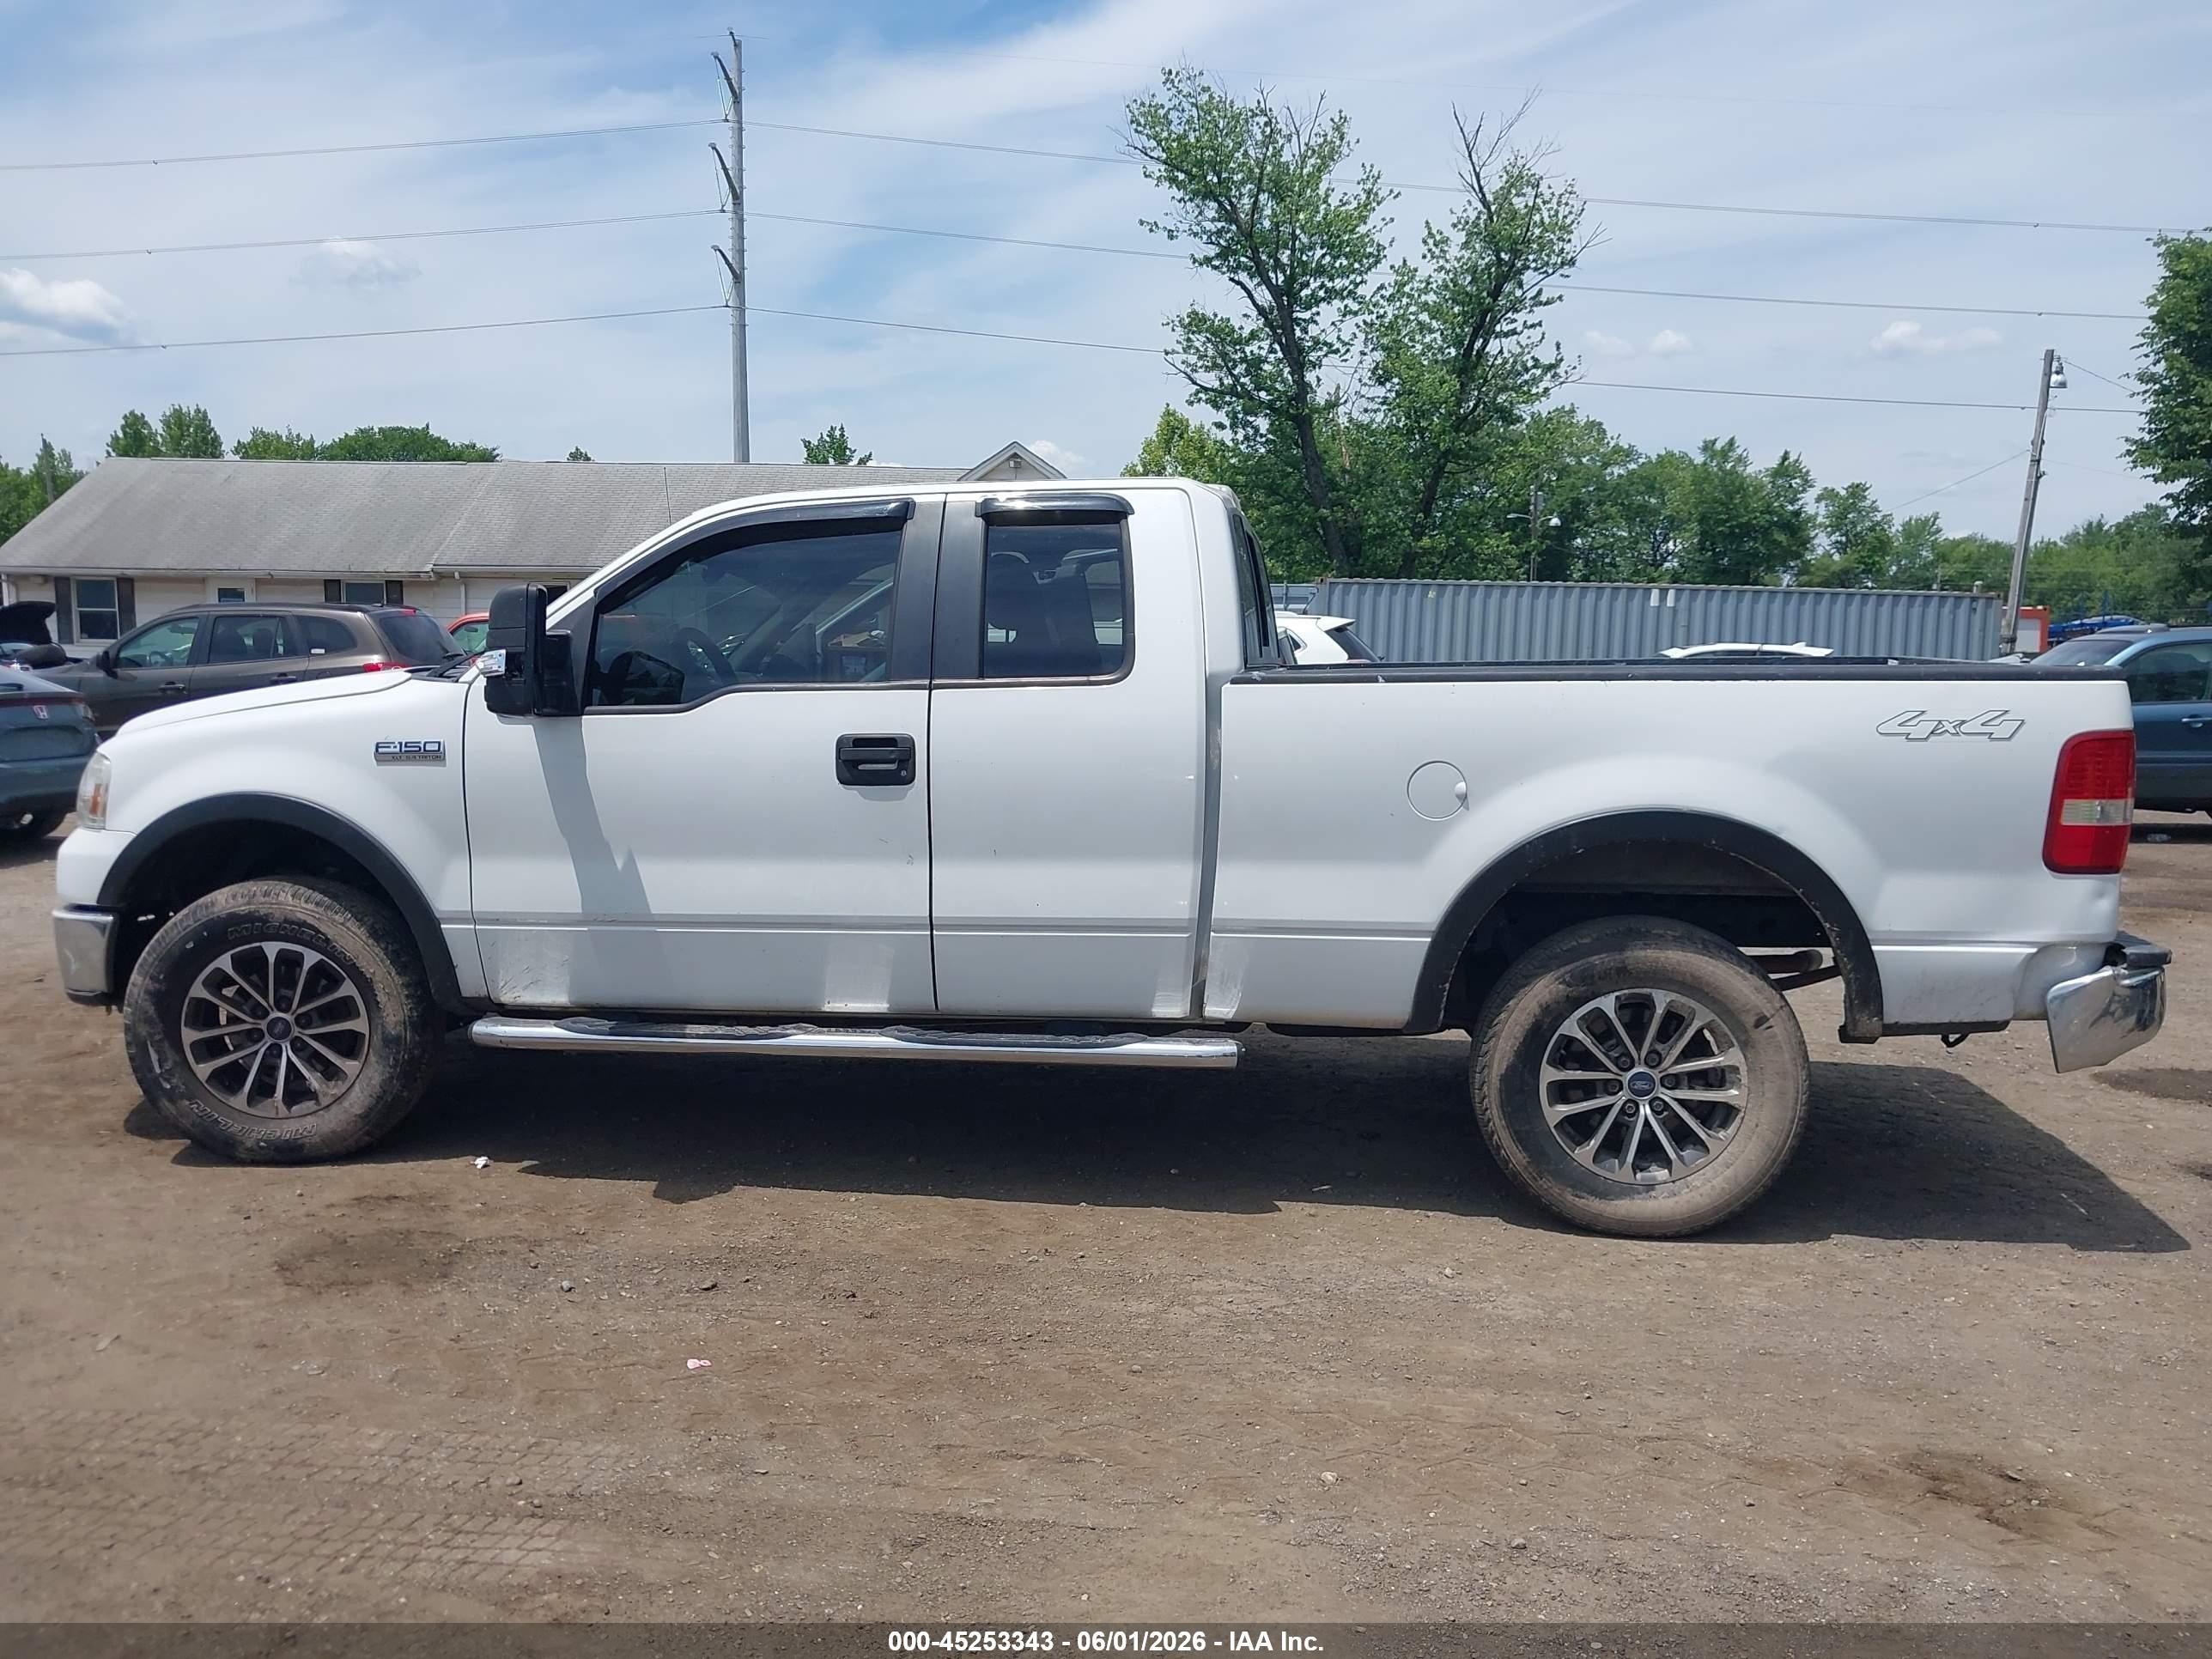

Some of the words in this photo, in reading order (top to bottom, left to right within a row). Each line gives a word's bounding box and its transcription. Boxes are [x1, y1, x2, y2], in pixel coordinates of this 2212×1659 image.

[1875, 709, 2027, 741] 4x4
[227, 922, 354, 966] MICHELIN
[189, 1098, 318, 1141] MICHELIN
